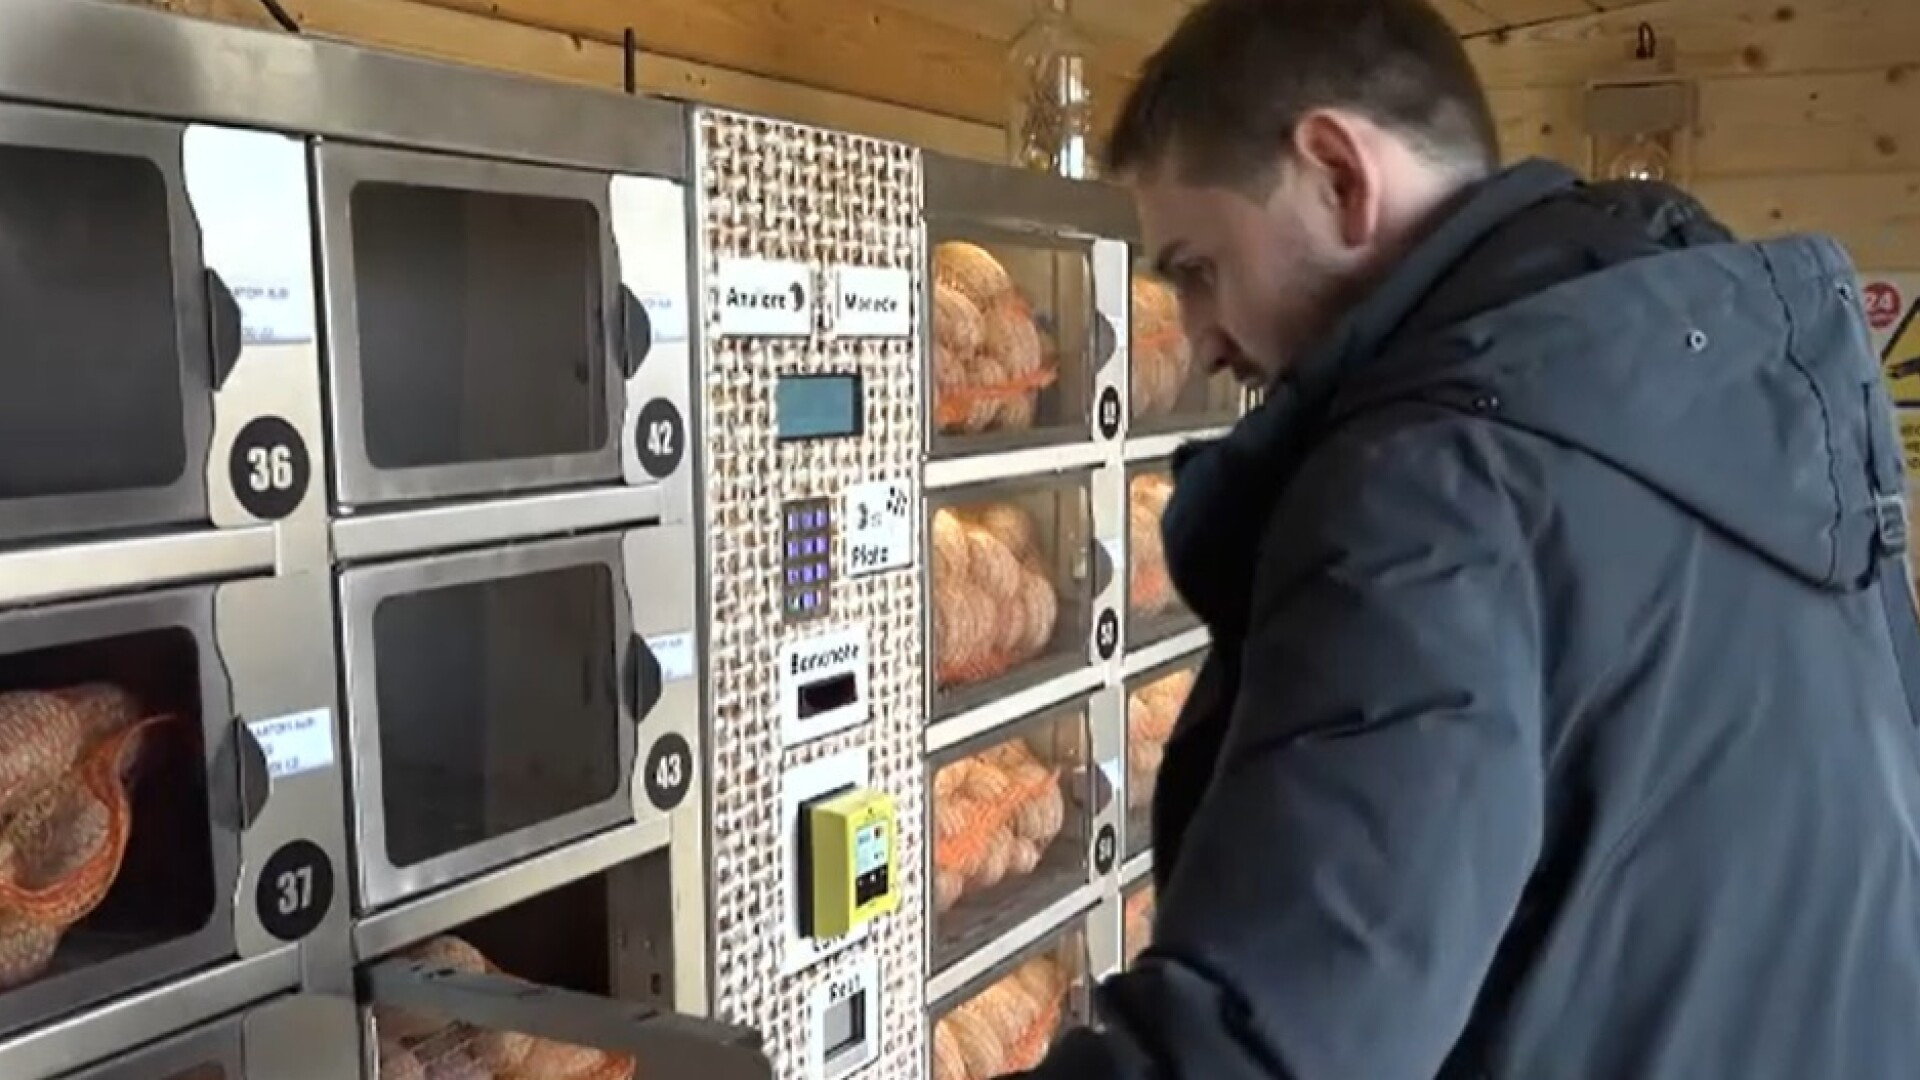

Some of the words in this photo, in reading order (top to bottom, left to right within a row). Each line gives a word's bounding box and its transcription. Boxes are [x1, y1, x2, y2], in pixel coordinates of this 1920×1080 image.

[648, 420, 674, 455] 42
[247, 444, 293, 492] 36
[657, 752, 682, 789] 43
[277, 865, 312, 915] 37
